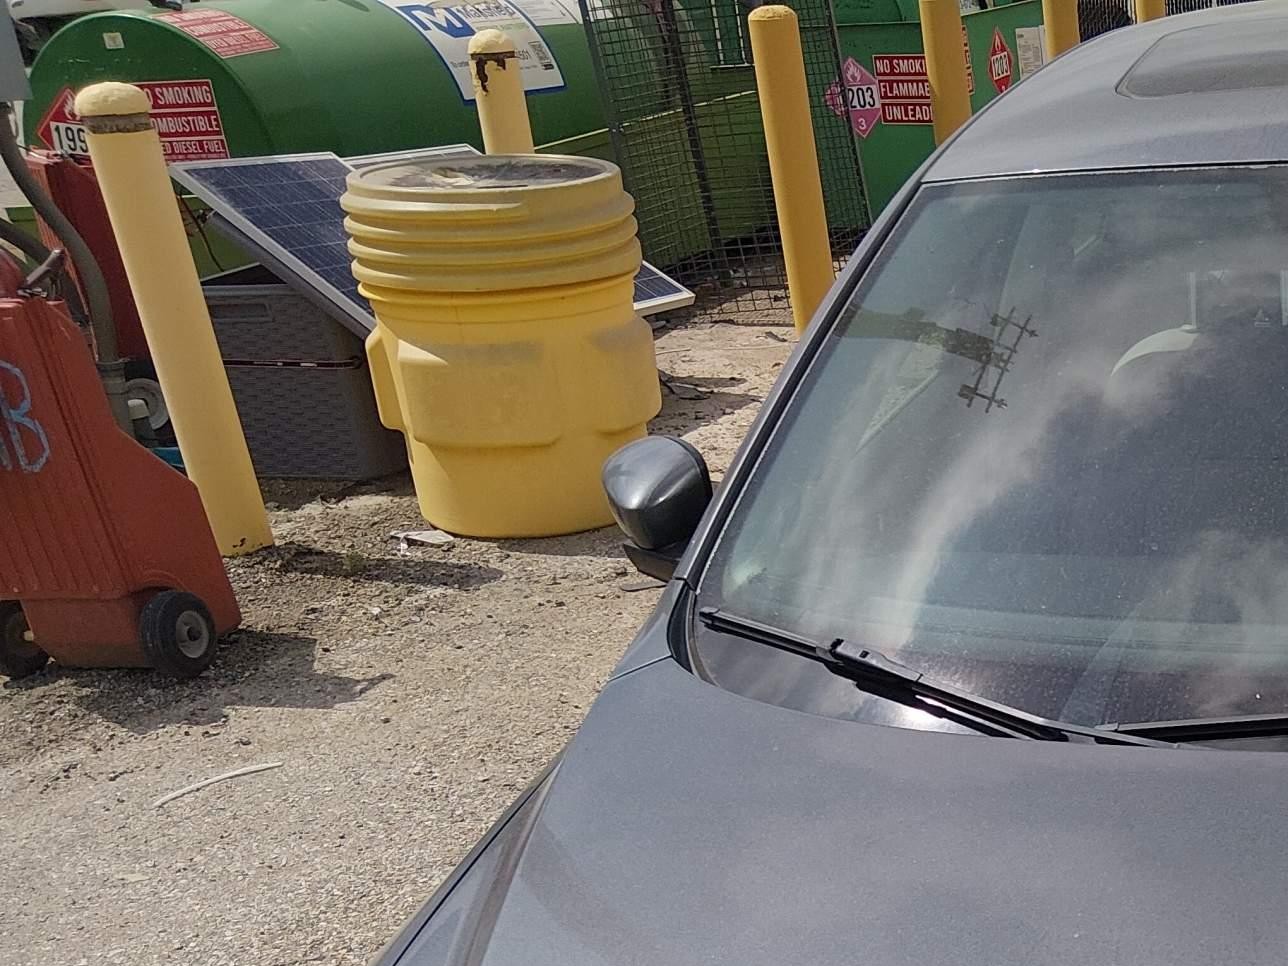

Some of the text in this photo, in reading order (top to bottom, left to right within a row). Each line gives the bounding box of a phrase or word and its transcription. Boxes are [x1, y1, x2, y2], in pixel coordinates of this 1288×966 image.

[876, 58, 926, 73] NO SMOKI
[156, 85, 212, 105] SMOKING
[847, 87, 876, 108] 203
[886, 105, 933, 120] UNLEAD
[150, 115, 220, 133] OMBUSTIBLE
[858, 118, 866, 130] 3
[54, 124, 88, 154] 199
[173, 141, 202, 153] DIESEL
[203, 140, 226, 152] FUEL
